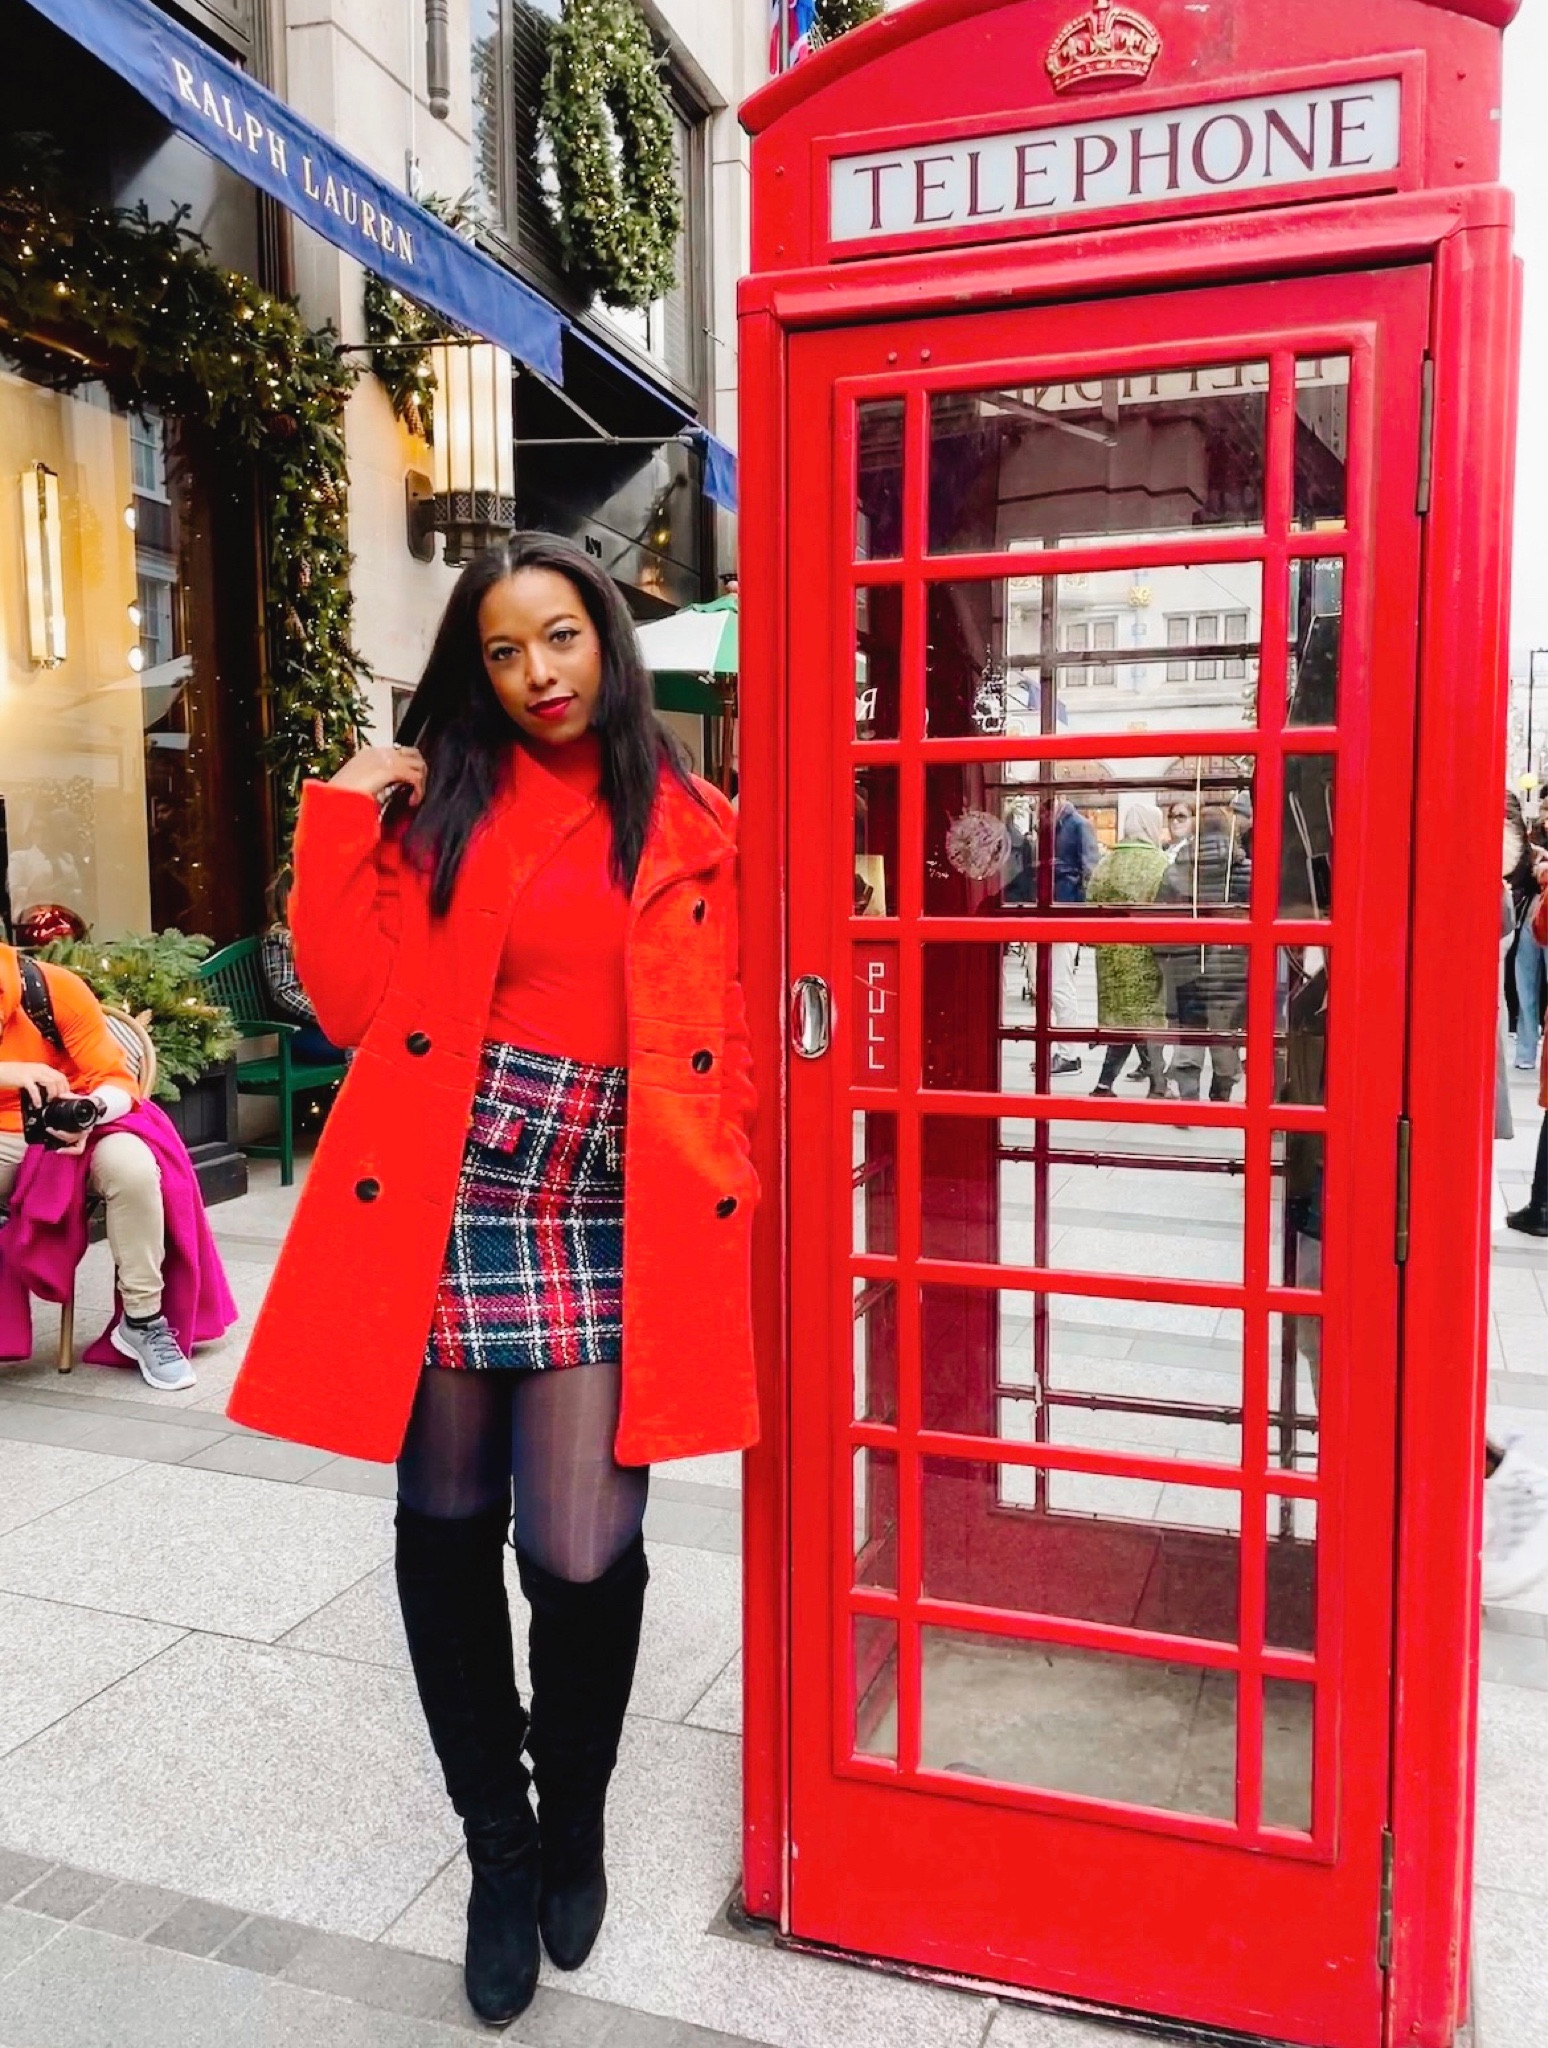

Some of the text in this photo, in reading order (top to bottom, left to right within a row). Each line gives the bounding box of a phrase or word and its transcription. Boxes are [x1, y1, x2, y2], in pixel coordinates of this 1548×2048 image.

[171, 57, 415, 265] RALPH LAUREN
[853, 94, 1376, 230] TELEPHONE
[868, 962, 885, 1069] PULL
